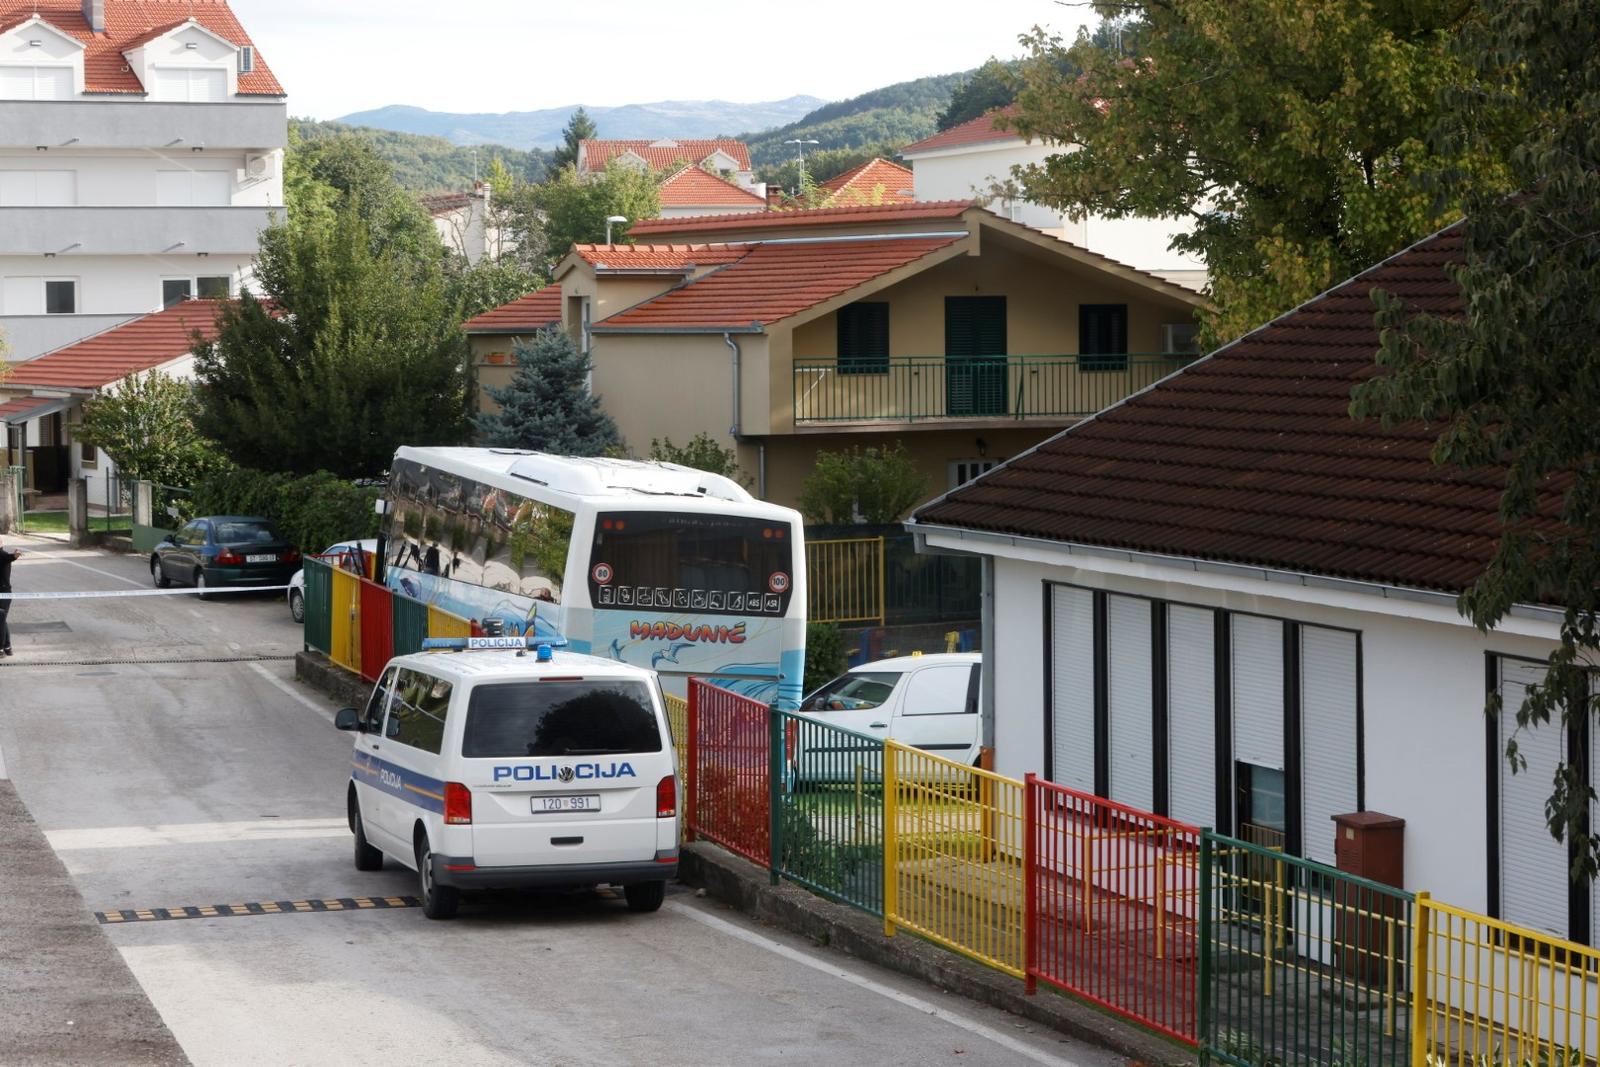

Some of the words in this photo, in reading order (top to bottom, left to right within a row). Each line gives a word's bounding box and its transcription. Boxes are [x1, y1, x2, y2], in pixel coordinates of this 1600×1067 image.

[598, 569, 608, 578] 80
[773, 577, 785, 587] 100
[749, 599, 760, 608] ABS
[766, 600, 778, 608] ASR
[471, 638, 523, 648] POLICIJA
[379, 768, 402, 791] POLICIJA
[542, 799, 562, 810] 120
[570, 797, 590, 809] 991
